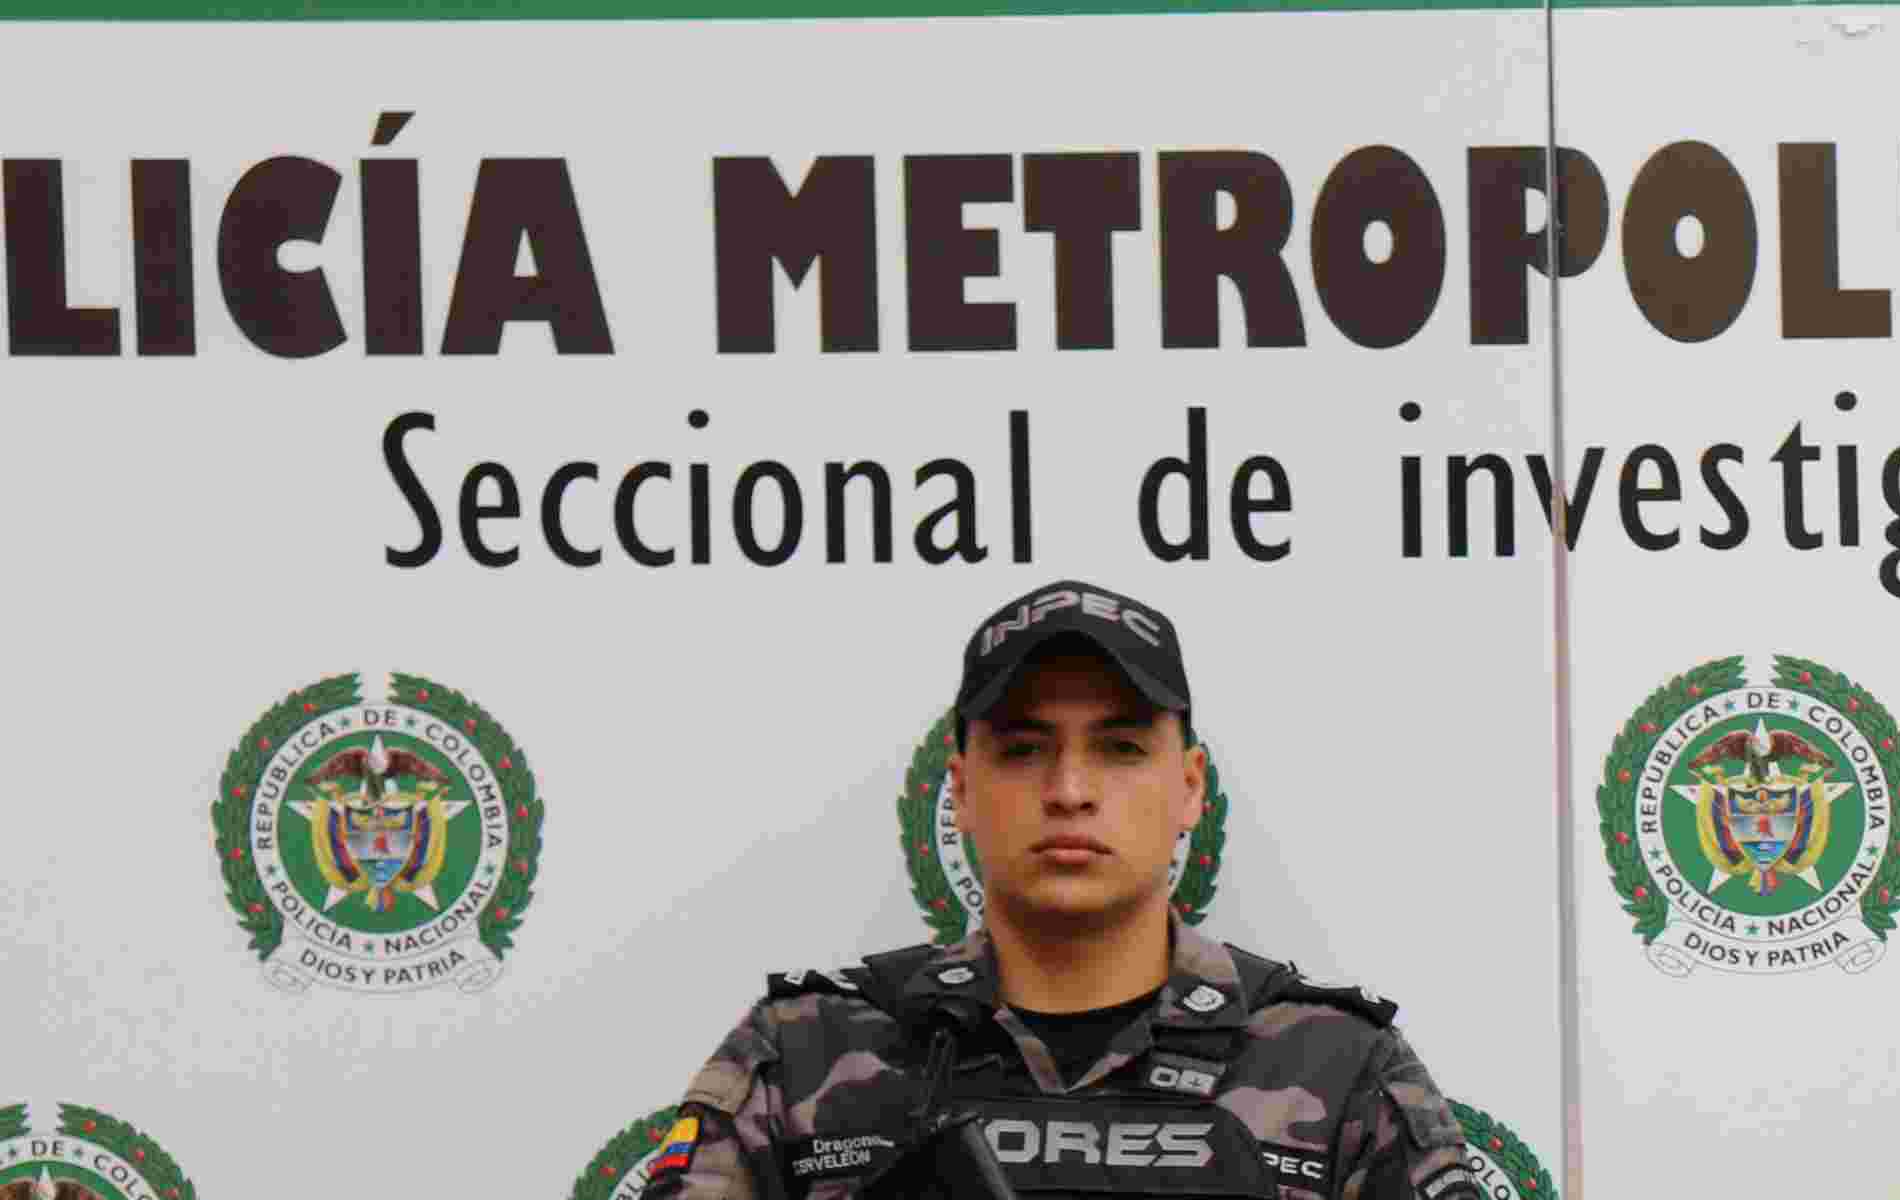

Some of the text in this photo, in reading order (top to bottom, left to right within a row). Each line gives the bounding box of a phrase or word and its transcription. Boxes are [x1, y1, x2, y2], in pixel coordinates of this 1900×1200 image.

[382, 409, 1034, 569] Seccional
[1138, 406, 1293, 563] de
[980, 590, 1161, 657] INPEC
[256, 709, 502, 850] REPUBLICA DE COLOMBIA
[1641, 692, 1886, 834] REPUBLICA DE COLOMBIA
[271, 881, 494, 955] POLICIA NACIONAL
[1656, 860, 1877, 937] POLICIA NACIONAL
[384, 949, 466, 984] PATRIA
[1767, 930, 1850, 967] PATRIA
[31, 1140, 65, 1158] DE
[984, 1119, 1216, 1168] ORES
[1262, 1152, 1324, 1179] PEC
